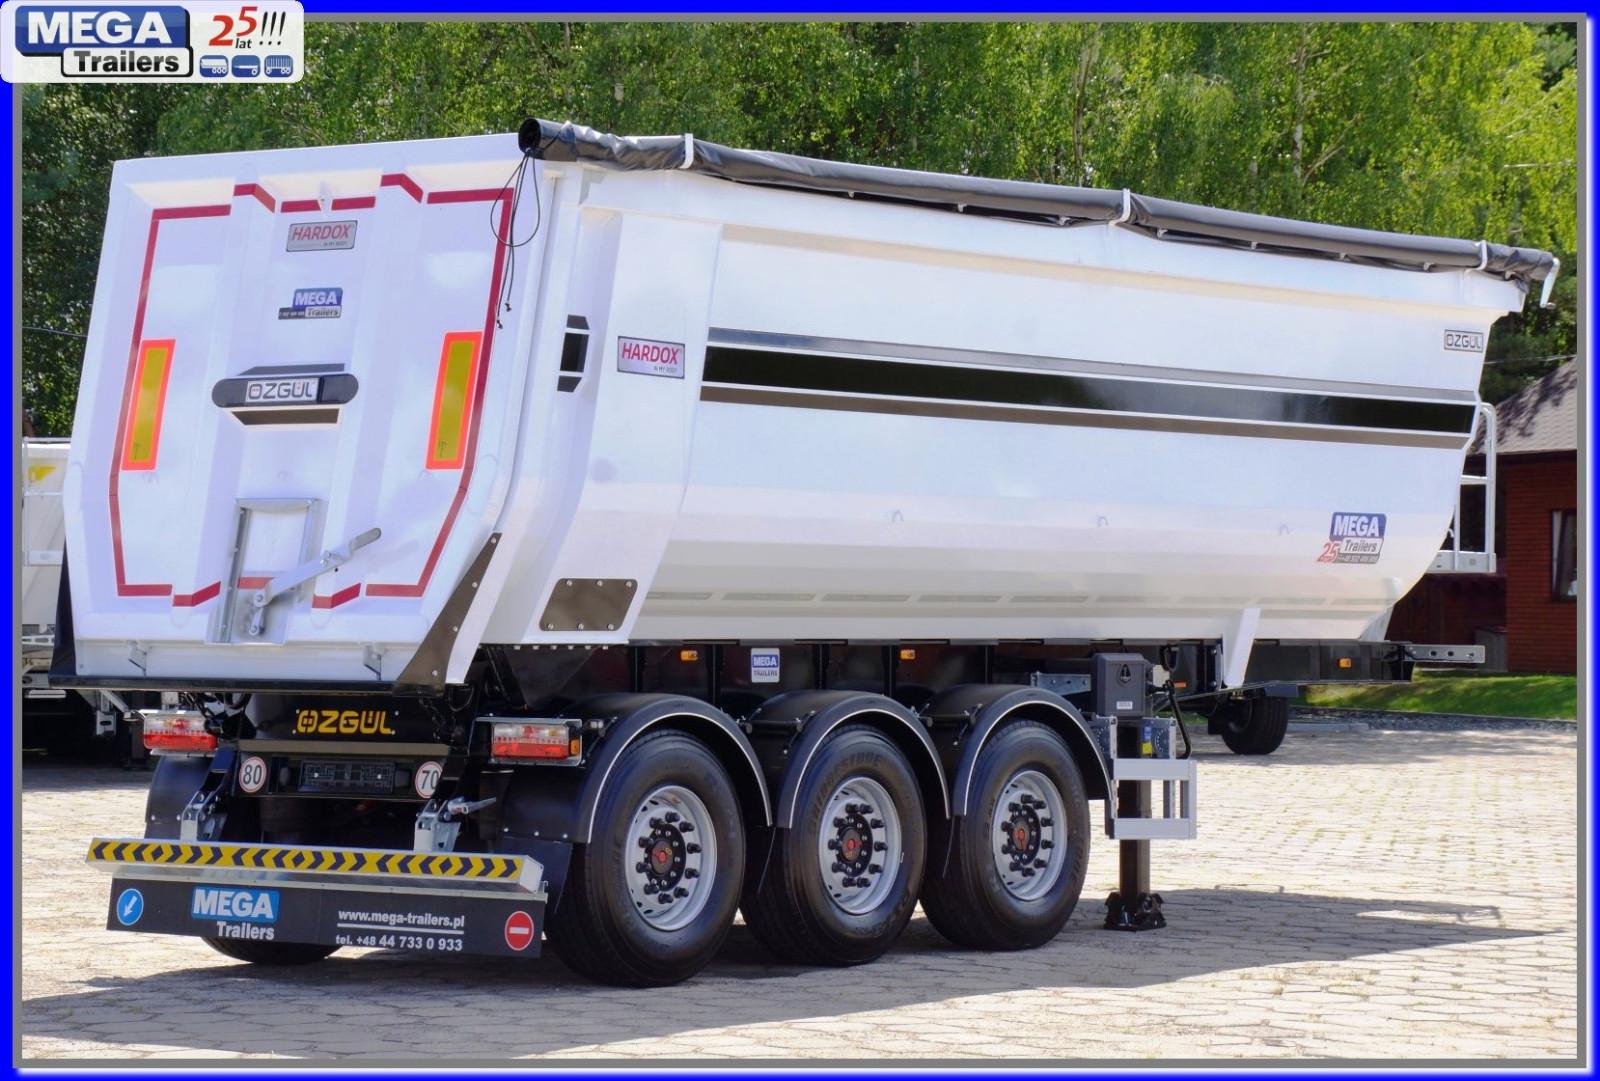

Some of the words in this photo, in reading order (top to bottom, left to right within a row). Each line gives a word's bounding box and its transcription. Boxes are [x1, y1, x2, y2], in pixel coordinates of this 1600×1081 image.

[291, 224, 352, 241] HARDOX
[294, 291, 338, 306] MEGA
[307, 307, 339, 317] Trailers
[622, 342, 679, 365] HARDOX
[1333, 514, 1380, 537] MEGA
[1317, 542, 1340, 562] 25
[1344, 539, 1378, 552] Trailers
[753, 656, 777, 667] MEGA
[243, 764, 262, 784] 80
[421, 769, 440, 790] 70
[193, 889, 274, 919] MEGA
[338, 910, 465, 929] www.mega-trailers.pl
[217, 920, 275, 940] Trailers
[335, 934, 353, 945] tel.
[356, 935, 376, 946] +48
[379, 934, 395, 948] 44
[399, 936, 423, 949] 733
[426, 937, 434, 949] 0
[438, 938, 463, 952] 933
